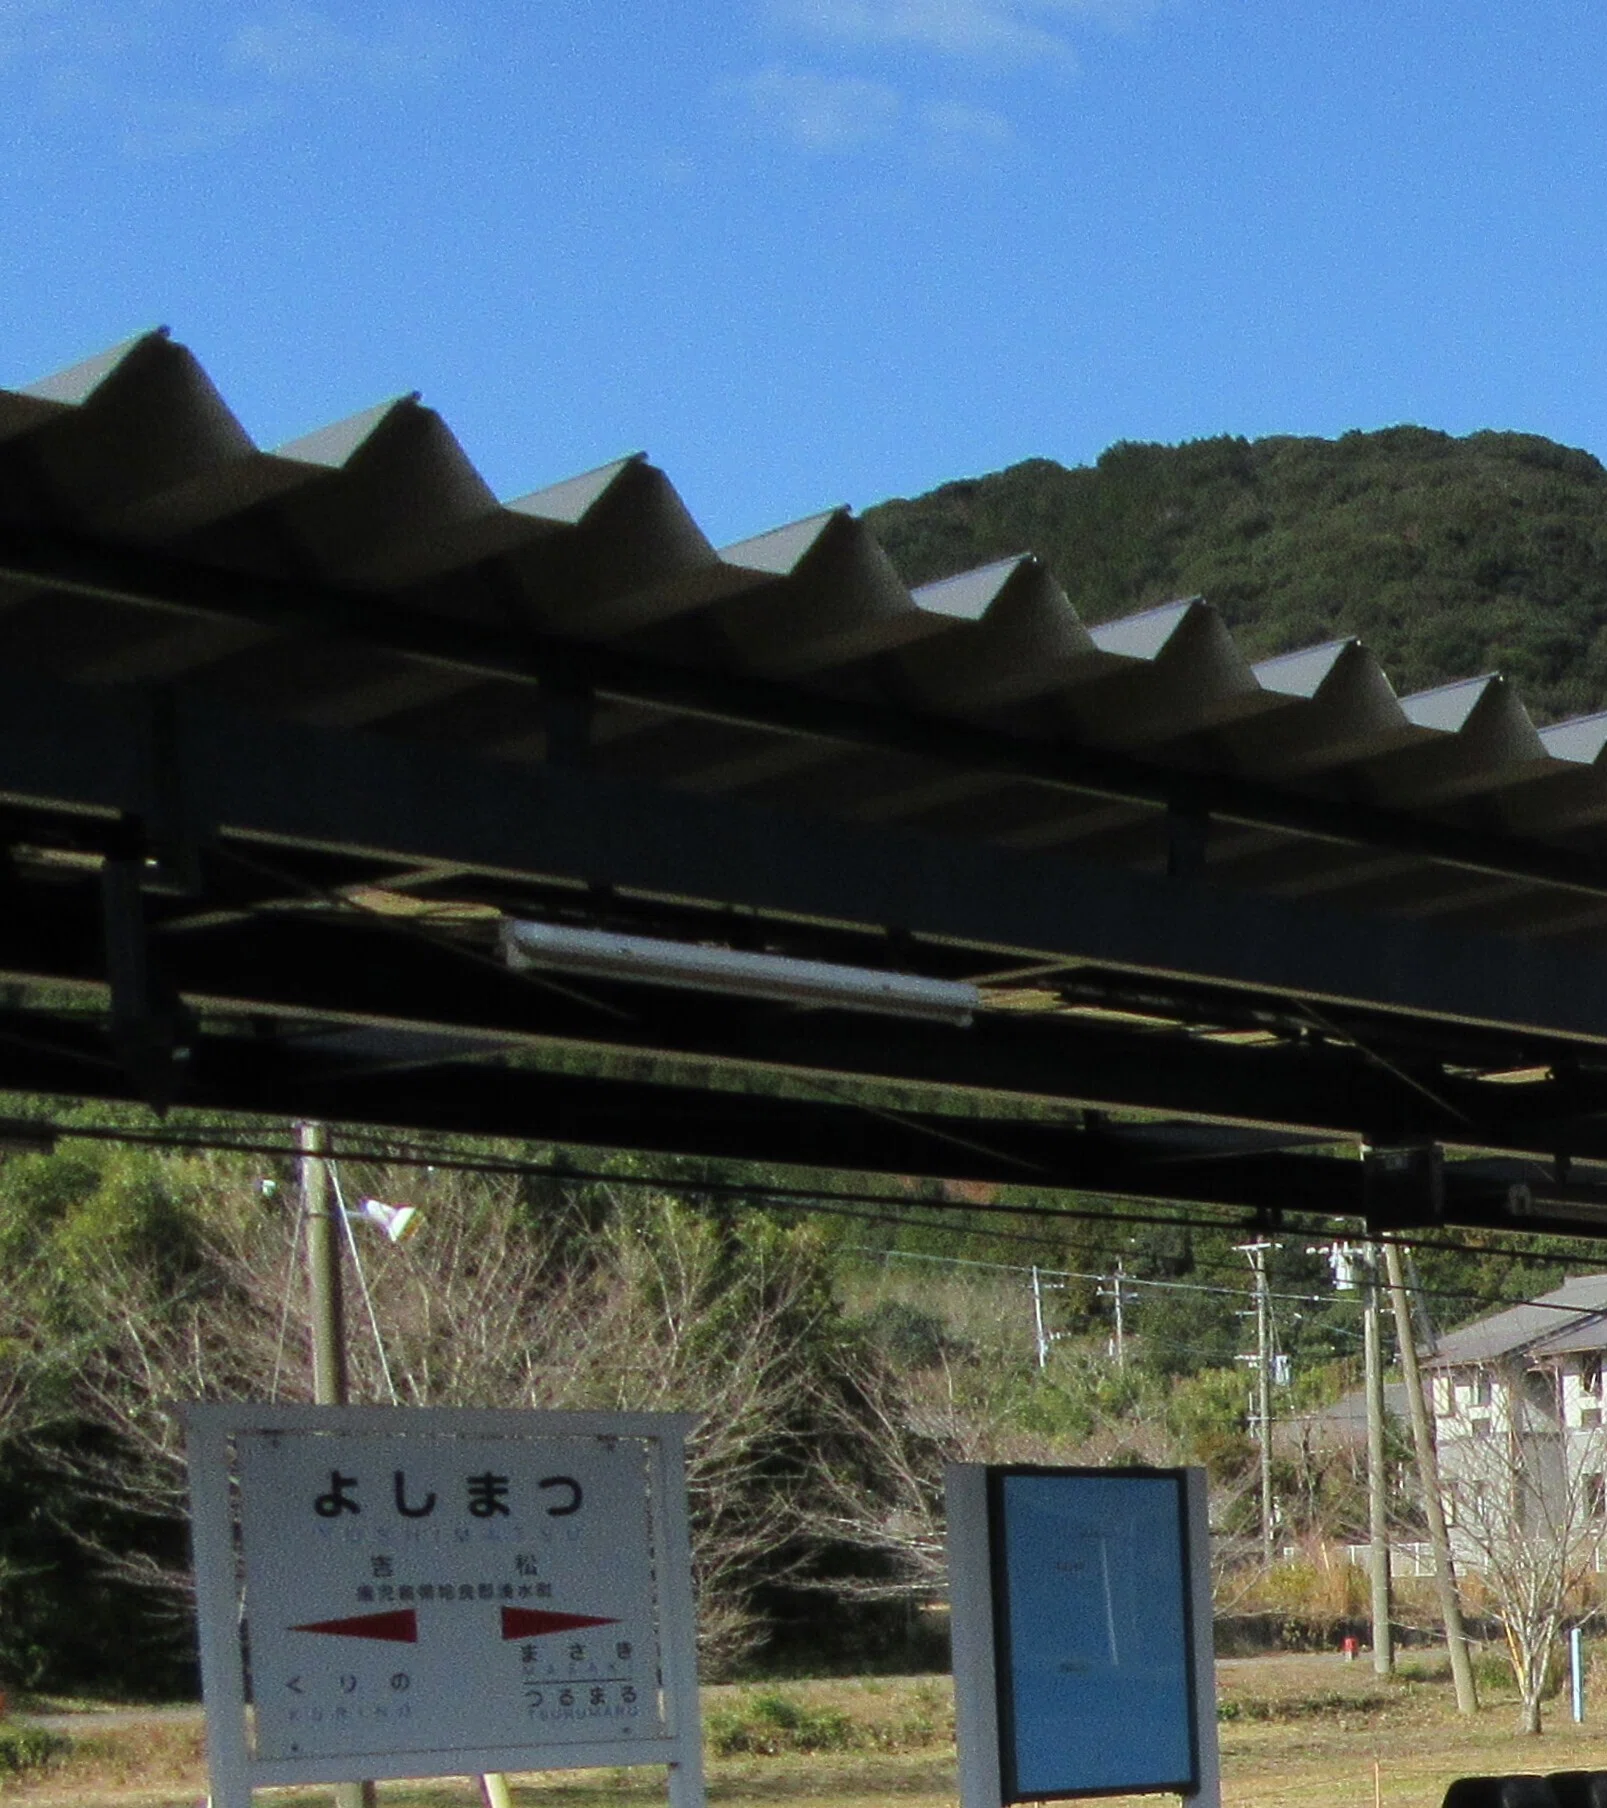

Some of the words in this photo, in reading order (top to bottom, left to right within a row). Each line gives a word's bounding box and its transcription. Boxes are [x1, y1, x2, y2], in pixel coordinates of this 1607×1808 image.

[314, 1470, 583, 1518] よしまつ
[285, 1671, 411, 1695] くりの
[523, 1685, 637, 1708] つるまる
